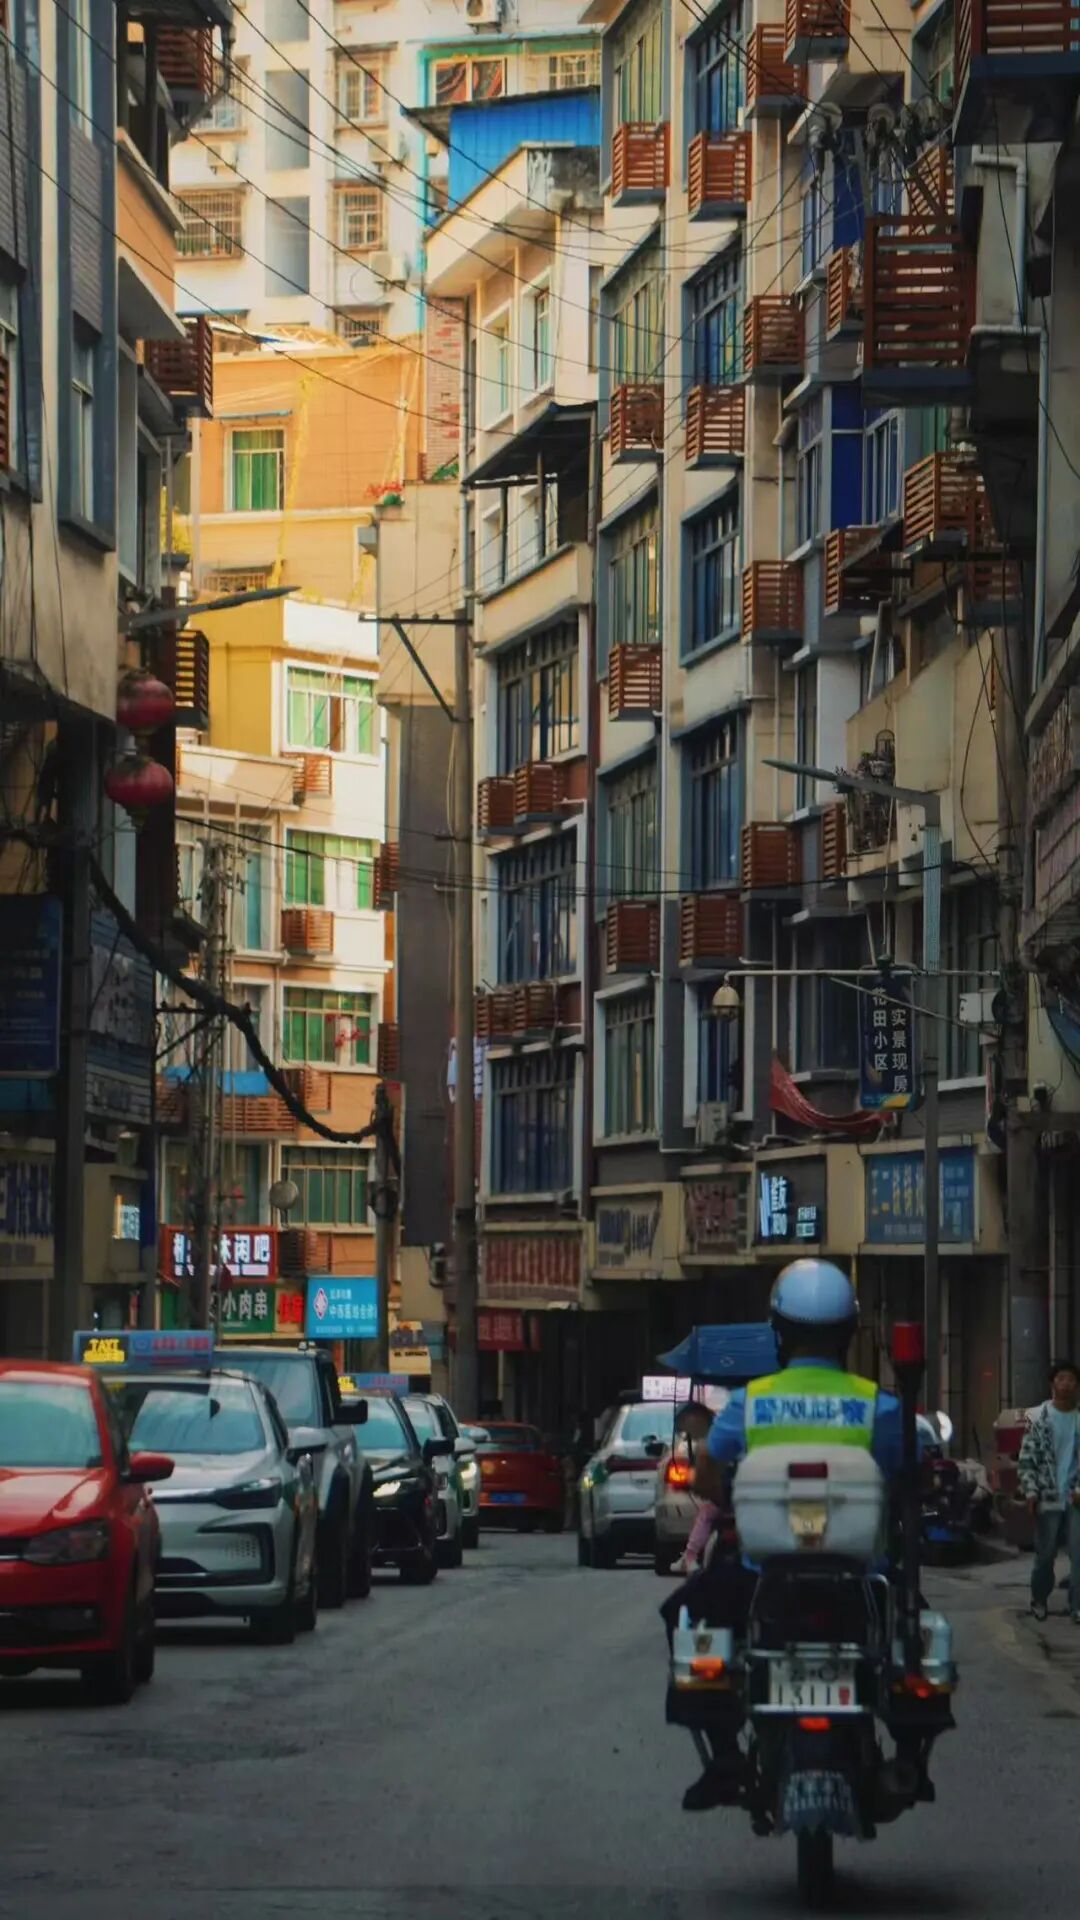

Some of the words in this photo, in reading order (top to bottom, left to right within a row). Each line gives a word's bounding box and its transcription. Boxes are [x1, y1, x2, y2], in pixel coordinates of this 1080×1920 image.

[871, 986, 889, 1071] 花田小区
[890, 1008, 909, 1093] 实景现房
[172, 1232, 271, 1263] 休闲吧
[329, 1303, 378, 1320] 中西医结合诊
[89, 1338, 120, 1353] TAXI
[782, 1398, 837, 1420] POLICE
